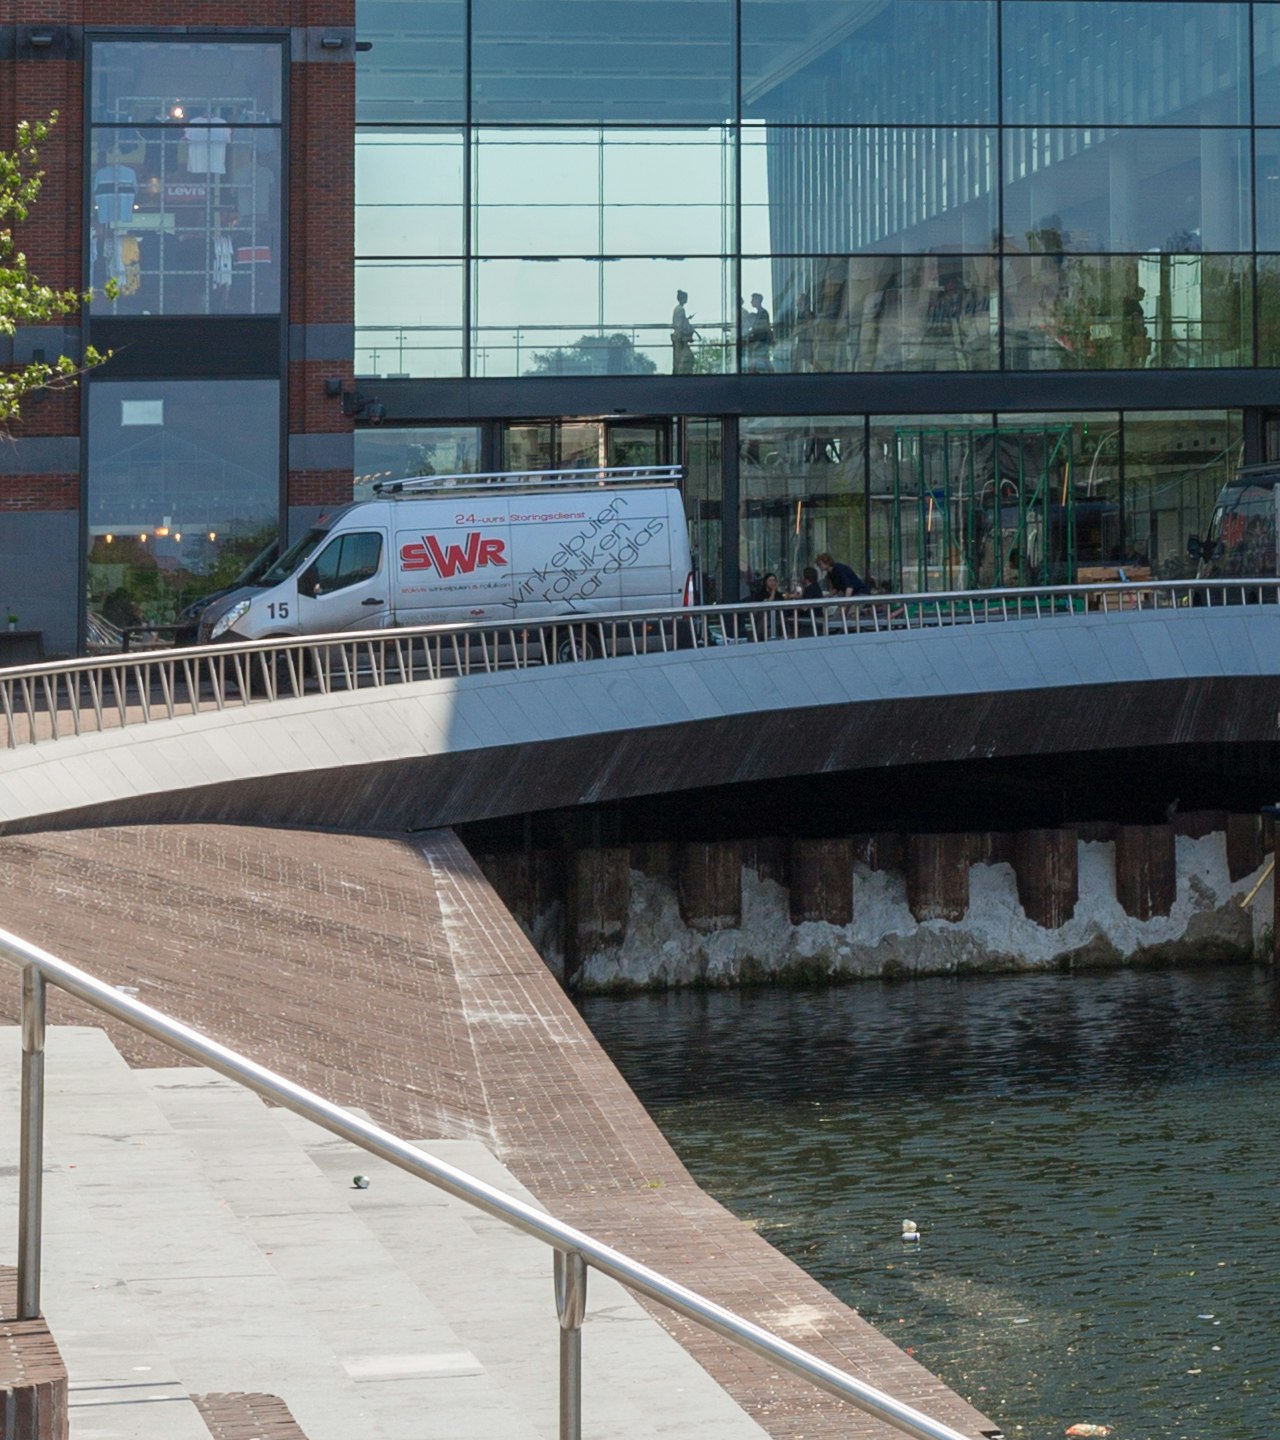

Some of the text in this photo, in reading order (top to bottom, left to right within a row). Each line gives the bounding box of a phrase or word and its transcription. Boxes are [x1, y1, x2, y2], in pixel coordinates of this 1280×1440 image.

[400, 532, 508, 579] SWR
[502, 497, 629, 609] winkelpuien
[542, 522, 631, 604] rolluiken
[562, 518, 664, 610] hardglas
[266, 602, 290, 620] 15
